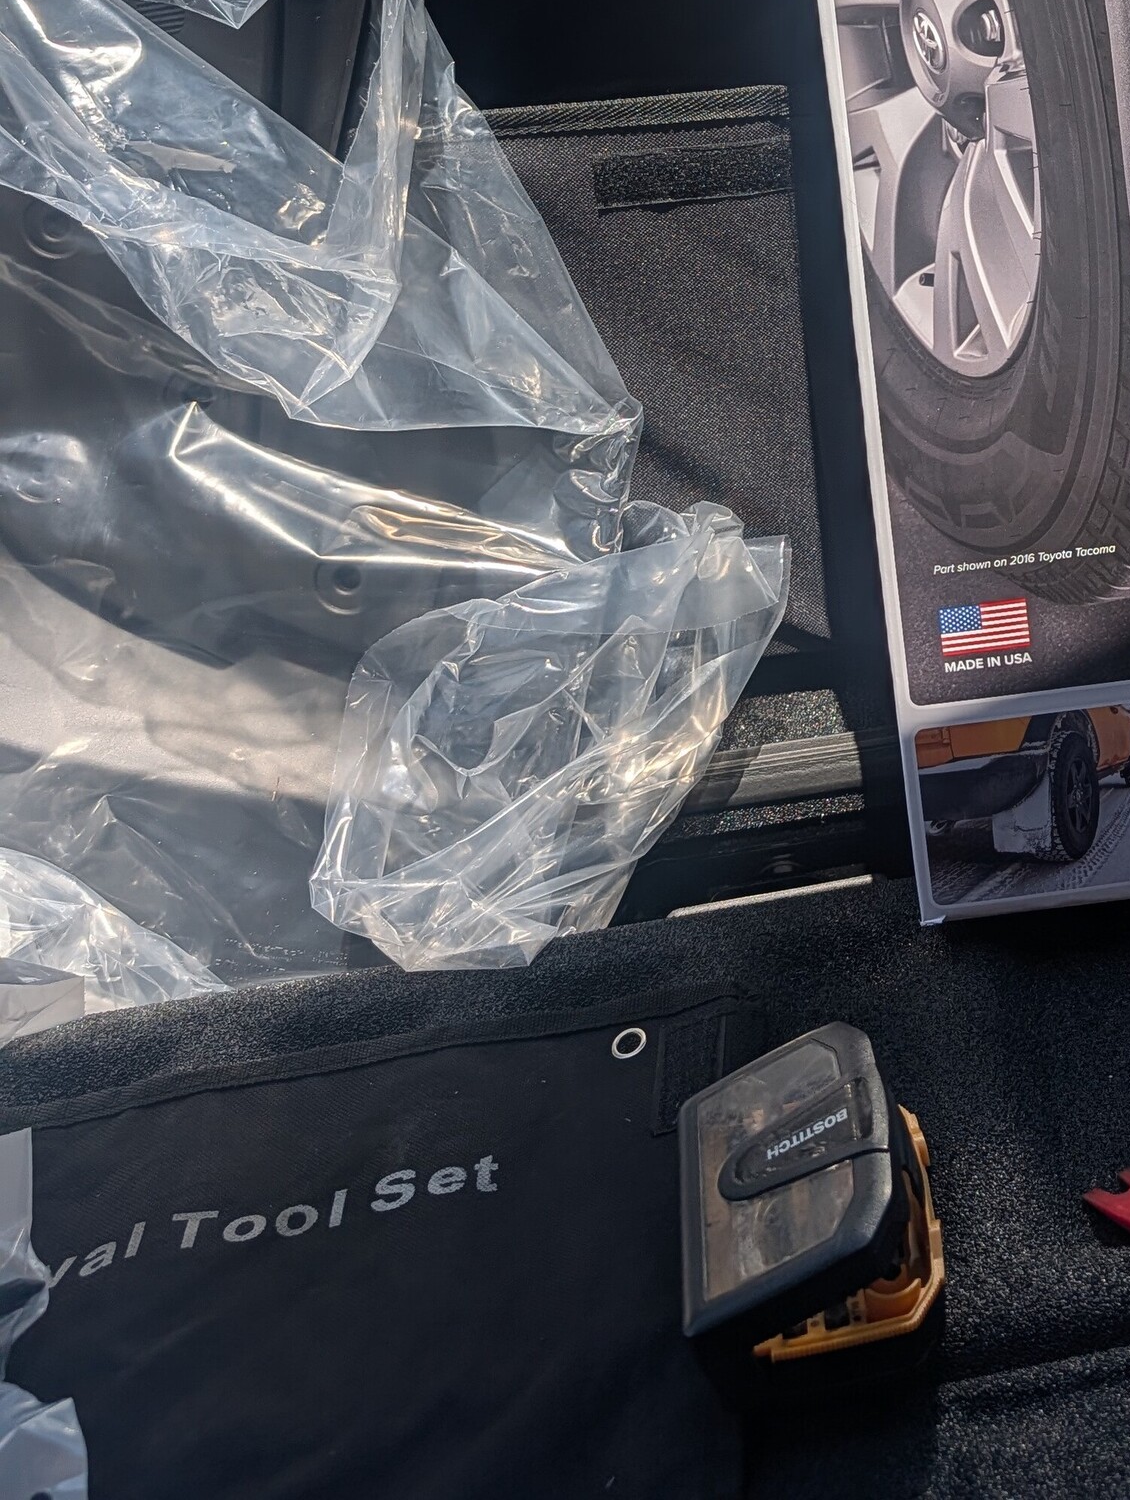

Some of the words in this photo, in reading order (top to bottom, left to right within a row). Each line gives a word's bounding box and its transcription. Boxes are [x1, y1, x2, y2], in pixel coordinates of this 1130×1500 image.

[933, 564, 955, 575] Part
[957, 560, 991, 572] shown
[993, 559, 1007, 567] on
[1010, 553, 1035, 565] 2016
[1038, 550, 1072, 563] Toyota
[1075, 544, 1116, 557] Tacoma
[944, 658, 984, 673] MADE
[987, 656, 1001, 667] IN
[1004, 652, 1032, 665] USA
[766, 1108, 848, 1160] BOSTITCH
[46, 1221, 146, 1289] val
[172, 1188, 349, 1249] Tool
[370, 1155, 499, 1212] Set
